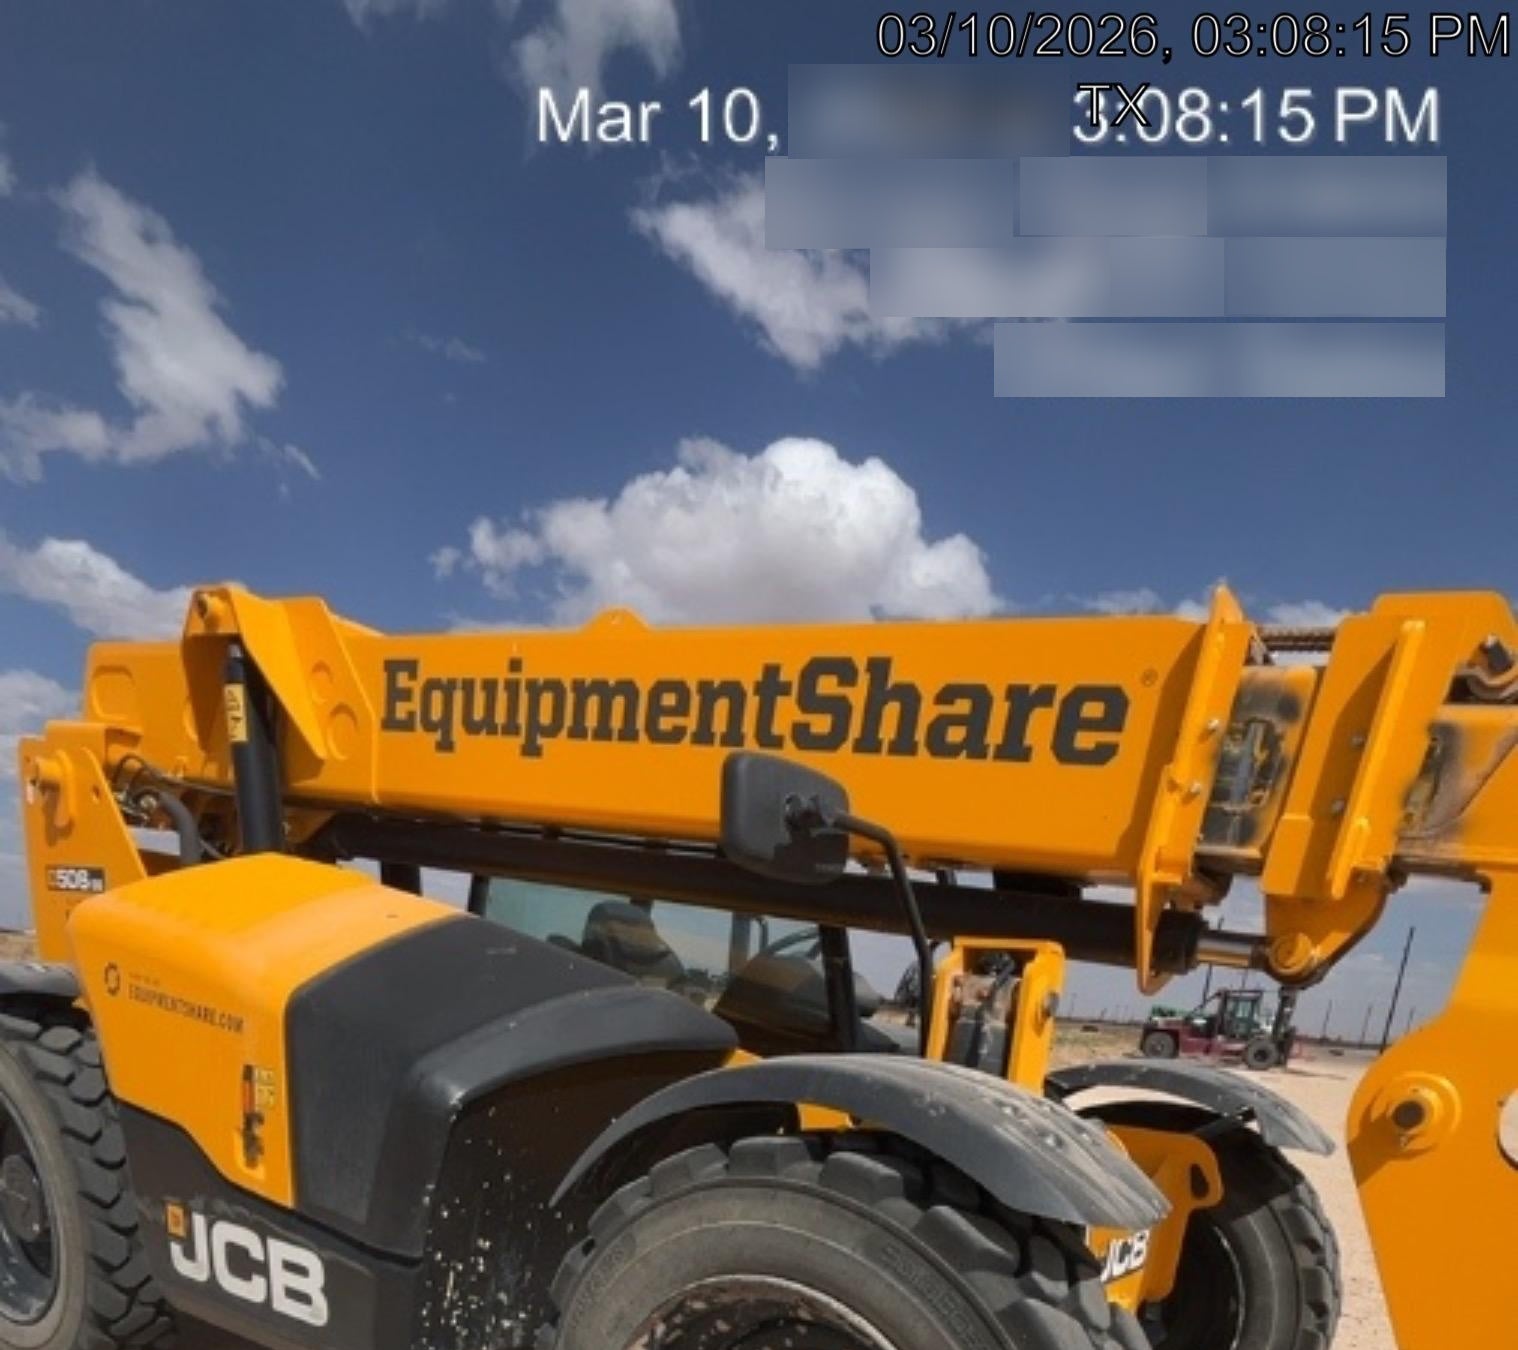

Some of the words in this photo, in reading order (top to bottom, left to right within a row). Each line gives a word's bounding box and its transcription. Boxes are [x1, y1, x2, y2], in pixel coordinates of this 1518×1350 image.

[381, 655, 1130, 767] EquipmentShare
[170, 1211, 328, 1327] JCB
[1100, 1229, 1149, 1283] JCB
